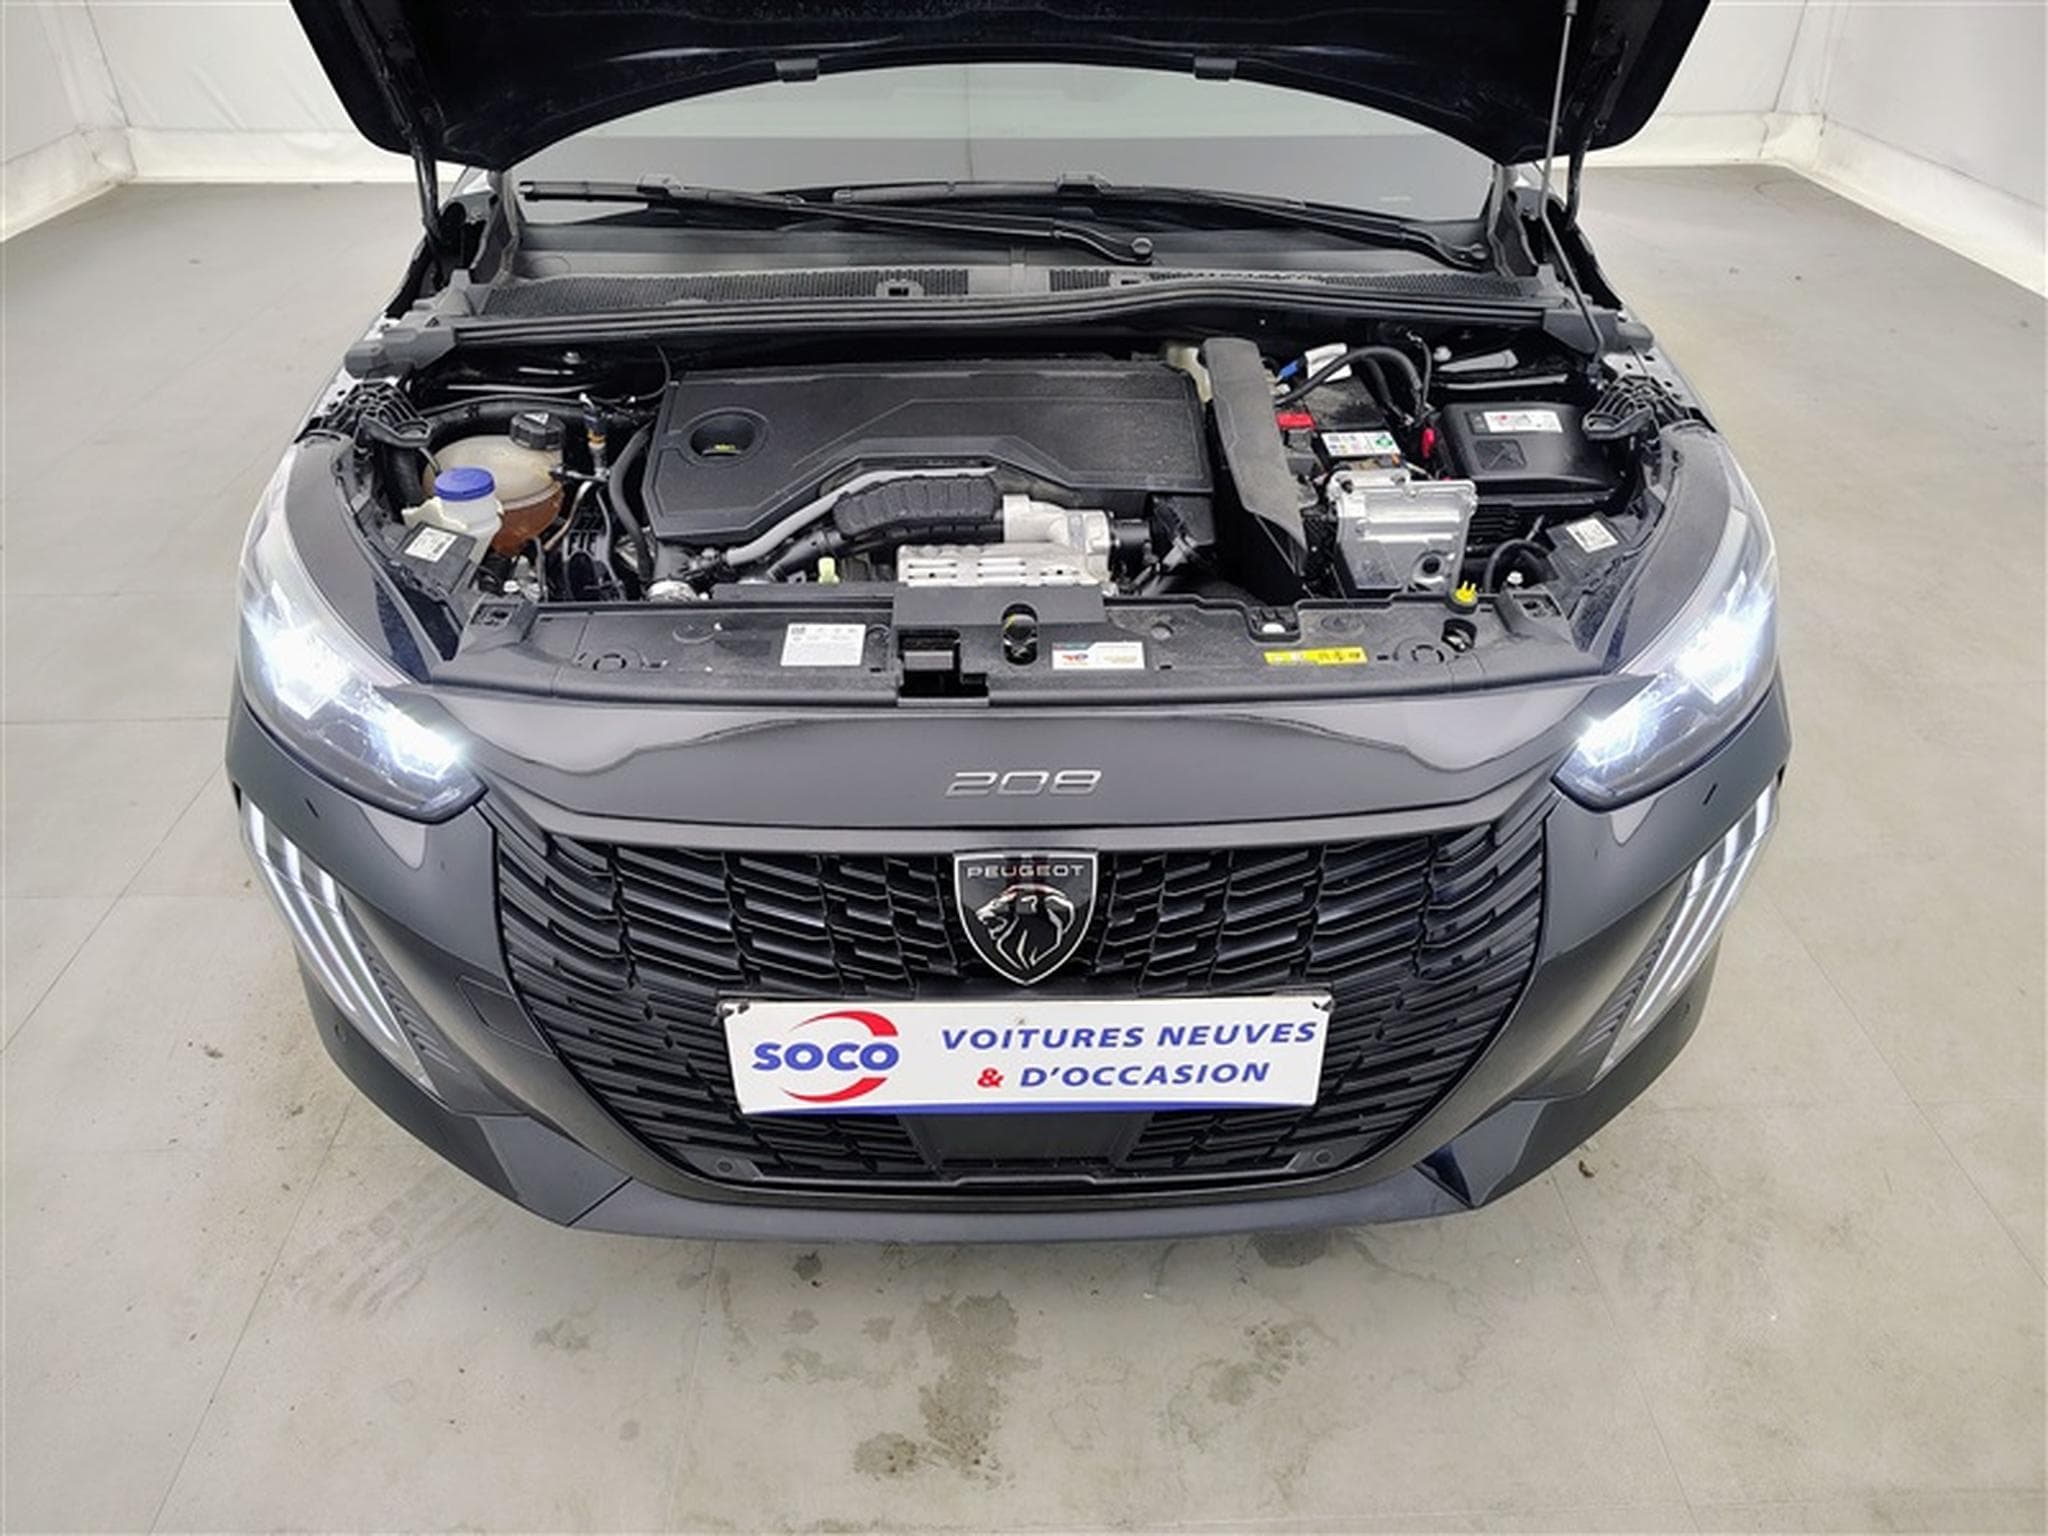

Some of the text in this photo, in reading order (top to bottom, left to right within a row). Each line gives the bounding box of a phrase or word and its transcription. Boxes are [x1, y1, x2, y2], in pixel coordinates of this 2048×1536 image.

[946, 769, 1102, 796] 208
[966, 864, 1085, 878] PEUGEOT
[941, 1022, 1318, 1049] VOITURES NEUVES
[752, 1042, 900, 1071] SOCO
[976, 1063, 1270, 1088] & D'OCCASION
